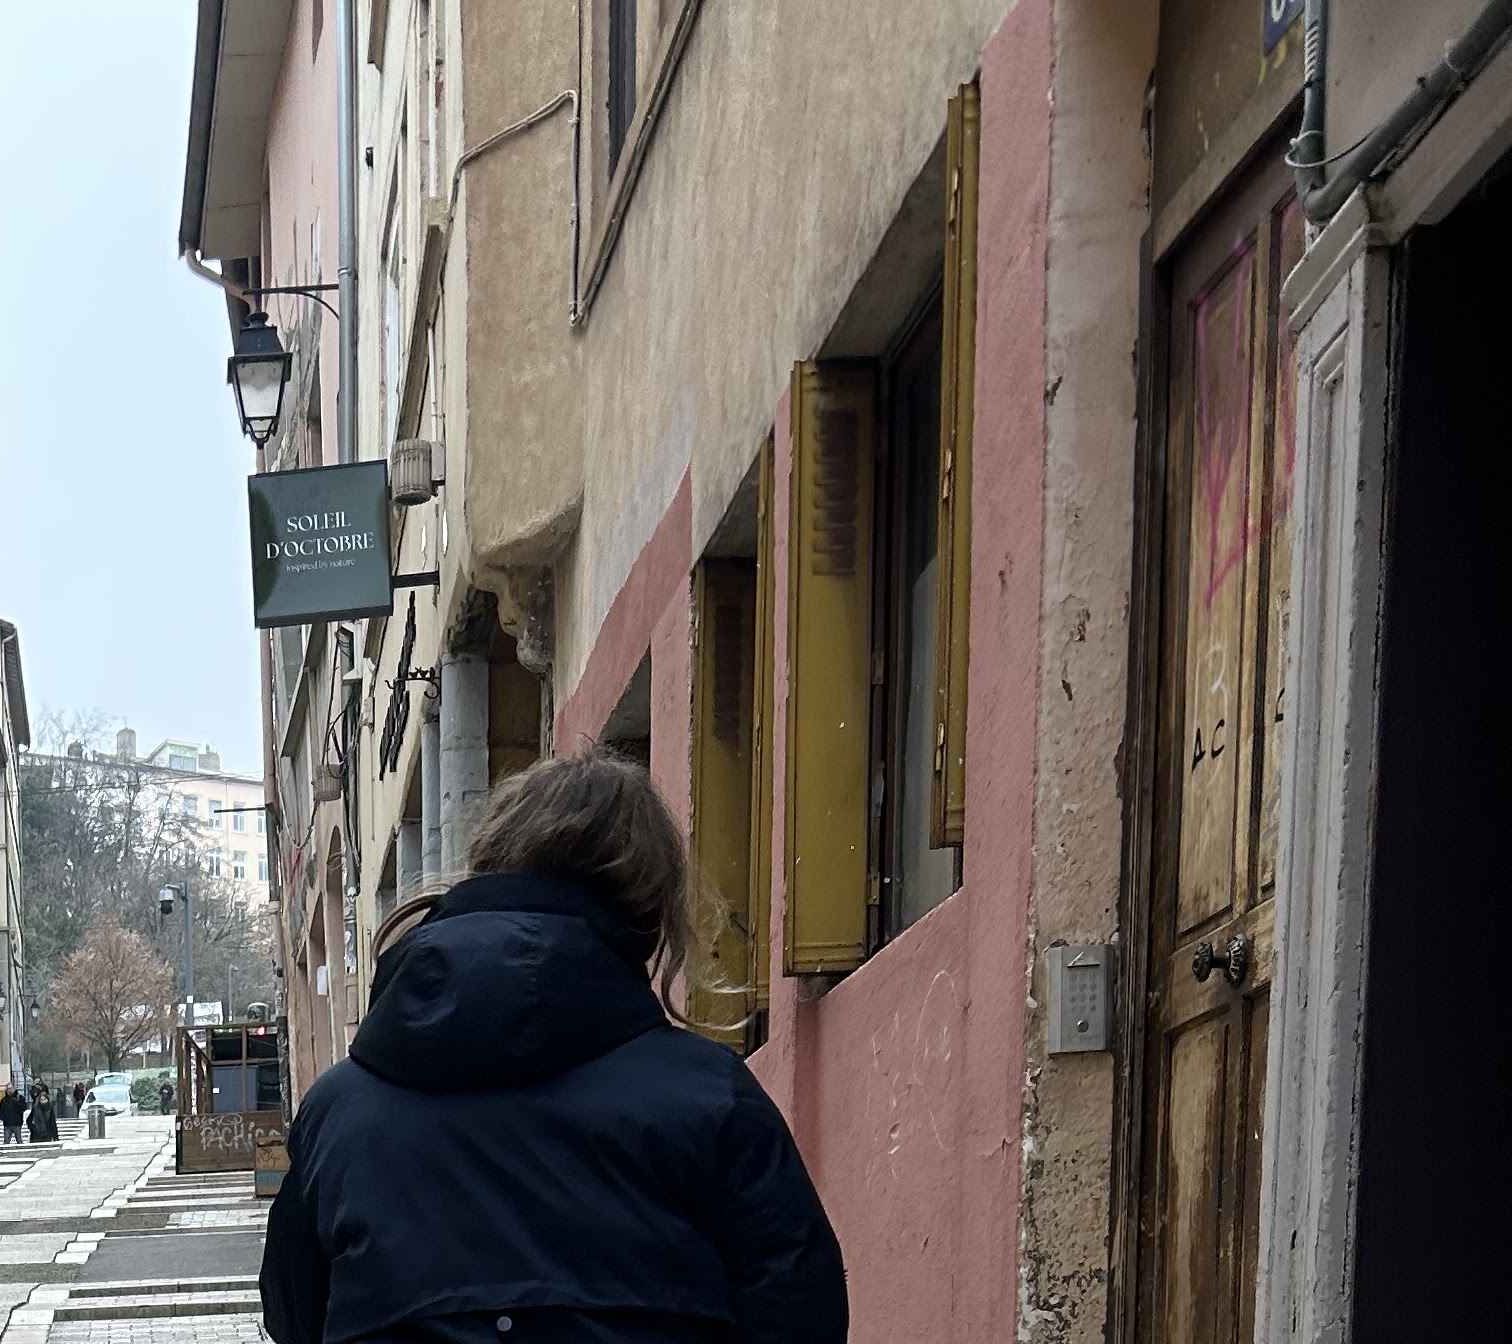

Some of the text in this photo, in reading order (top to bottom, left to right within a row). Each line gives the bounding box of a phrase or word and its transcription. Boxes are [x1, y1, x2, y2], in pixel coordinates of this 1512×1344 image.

[287, 511, 351, 533] SOLEIL
[266, 532, 375, 560] D'OCTOBRE
[286, 560, 317, 574] inspired
[329, 559, 356, 568] nature
